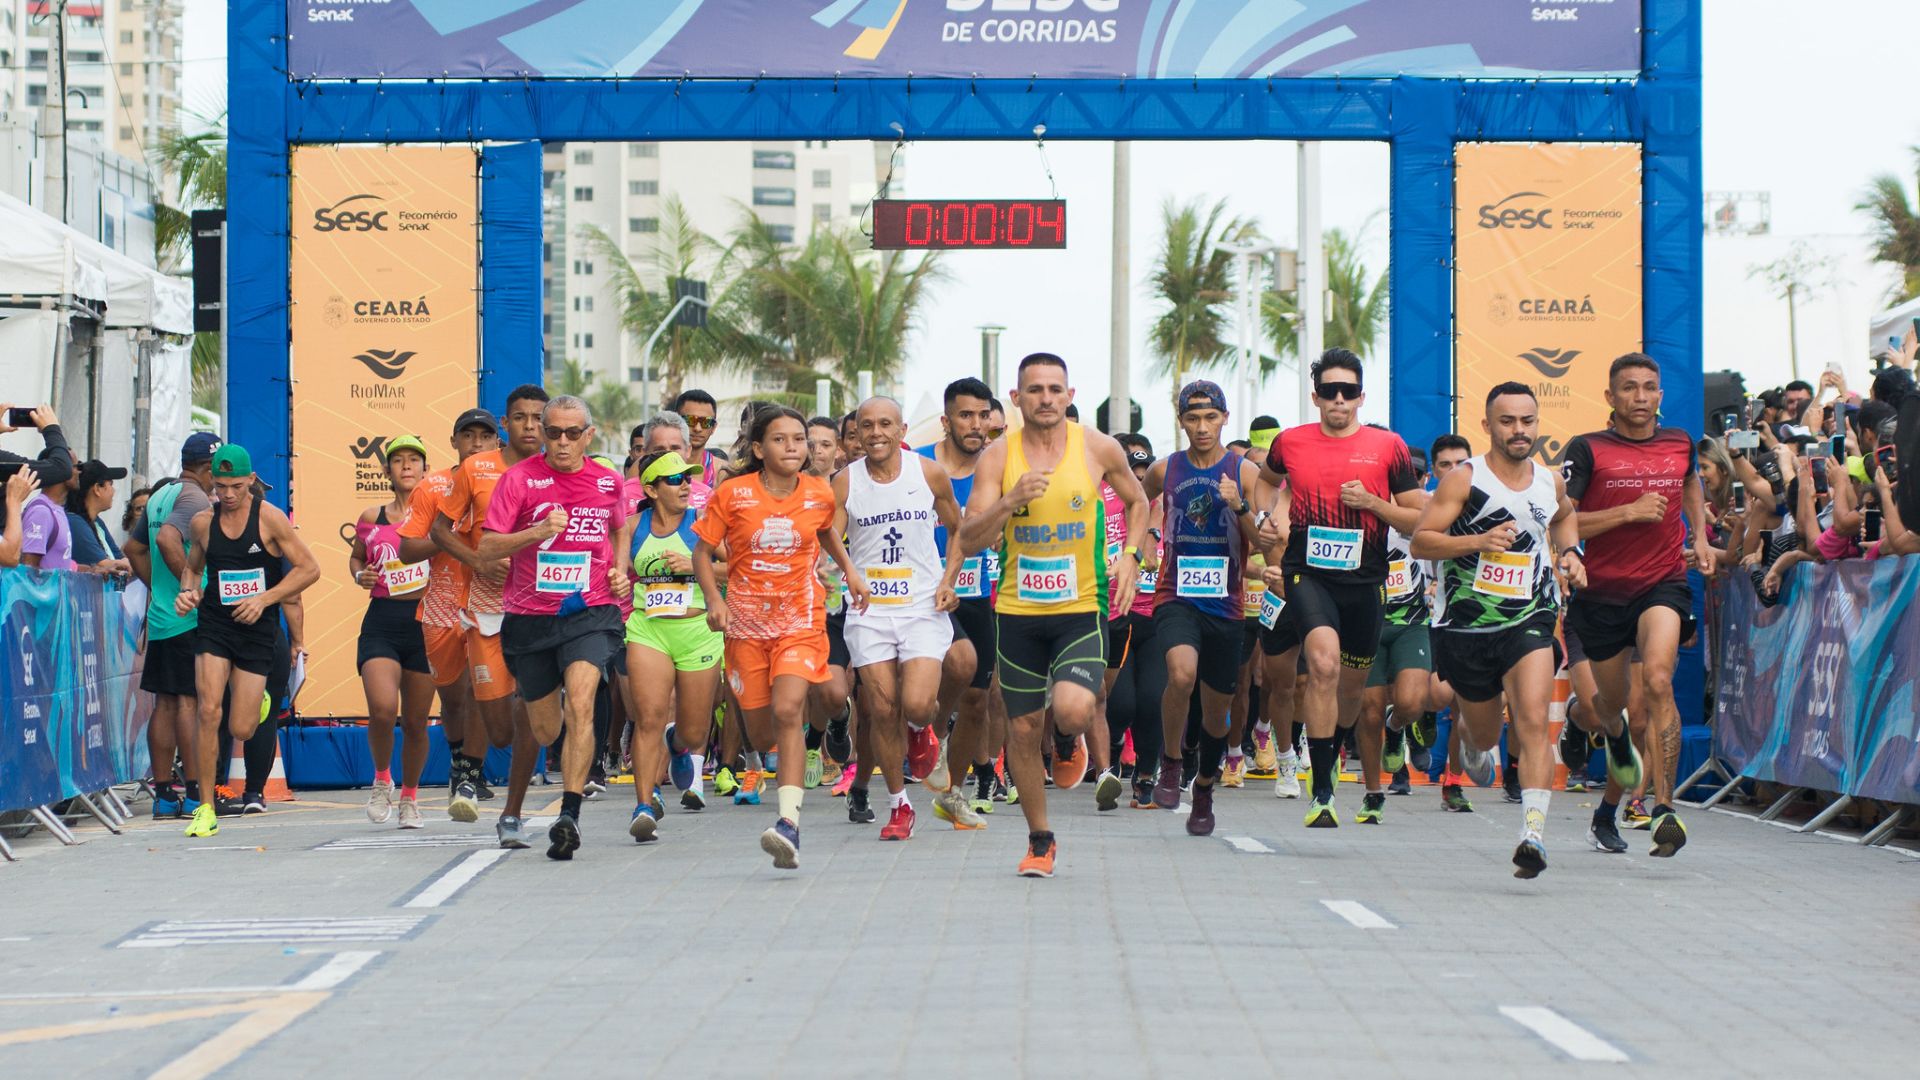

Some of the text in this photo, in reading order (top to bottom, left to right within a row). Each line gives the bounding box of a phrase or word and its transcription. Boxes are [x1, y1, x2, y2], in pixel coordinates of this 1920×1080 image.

[308, 9, 354, 22] Senac
[1531, 7, 1579, 21] Senac
[942, 19, 1117, 43] DE CORRIDAS
[398, 210, 458, 220] Fecomércio
[1563, 208, 1623, 218] Fecomércio
[398, 222, 430, 231] Senac
[906, 203, 1065, 246] 0:00:04
[1563, 220, 1595, 230] Senac
[354, 295, 431, 316] CEARÁ
[1518, 294, 1595, 314] CEARÁ
[353, 316, 431, 324] GOVERNO DO ESTADO
[367, 401, 406, 412] Kennedy
[571, 507, 610, 518] CIRCUITO
[857, 508, 928, 527] CAMPEÃO DO
[567, 518, 606, 534] SESC
[565, 534, 576, 542] DE
[881, 546, 905, 565] IJF
[1311, 541, 1354, 560] 3077
[390, 566, 424, 585] 5874
[541, 566, 583, 582] 4677
[958, 572, 975, 586] 86
[1022, 573, 1068, 590] 4866
[1182, 571, 1221, 586] 2543
[1386, 573, 1405, 587] 08
[1481, 563, 1525, 586] 5911
[223, 581, 259, 596] 5384
[870, 580, 909, 596] 3943
[647, 592, 684, 607] 3924
